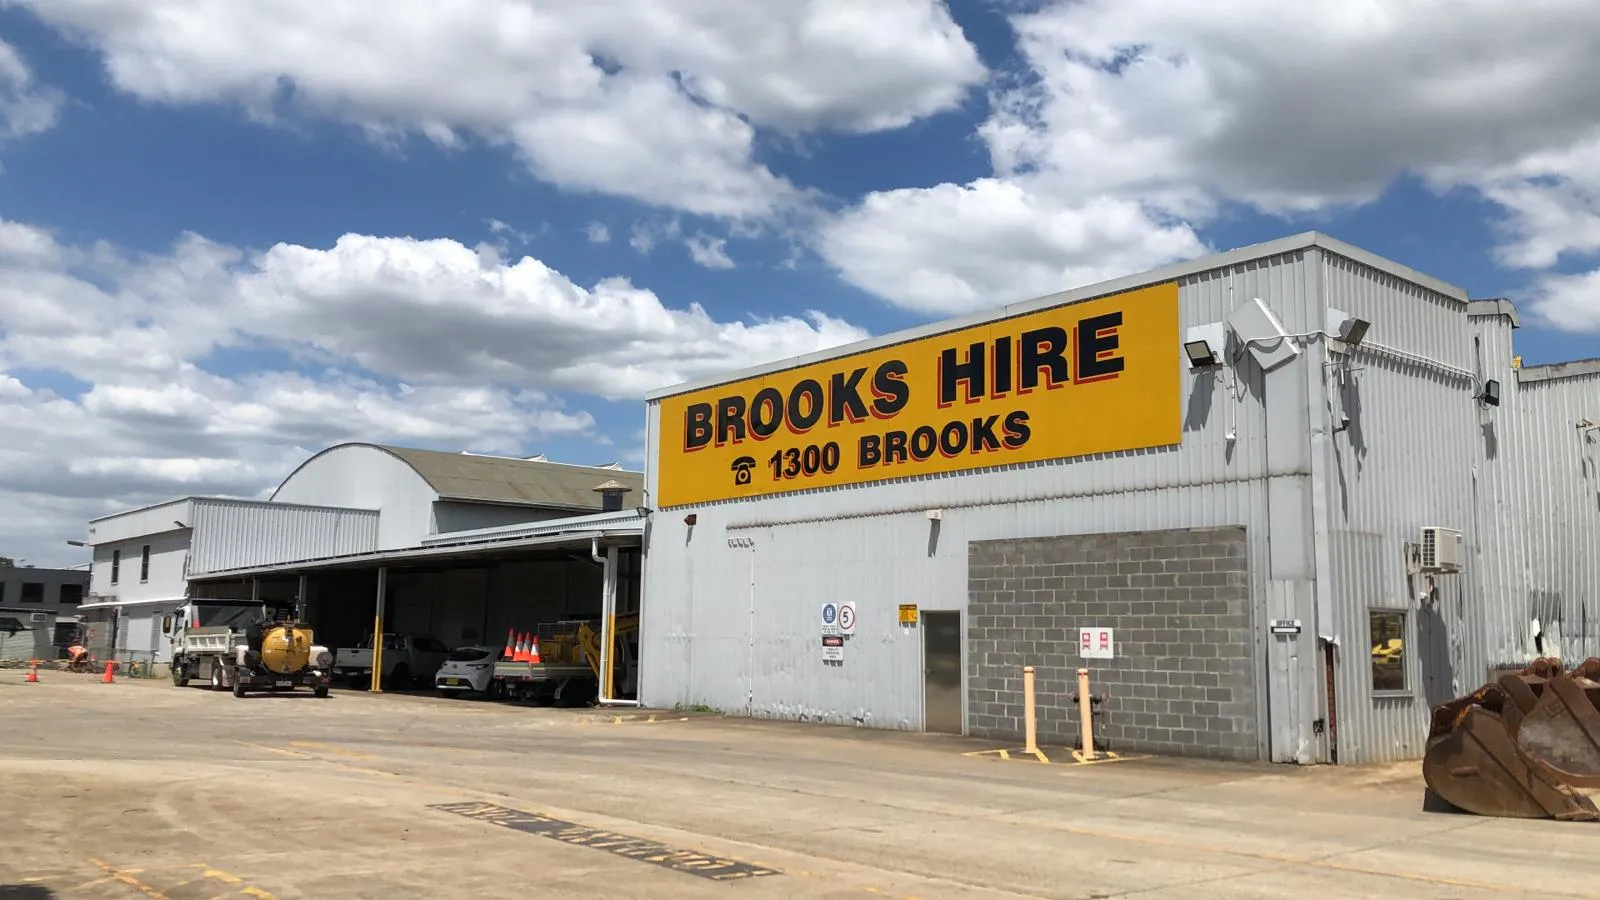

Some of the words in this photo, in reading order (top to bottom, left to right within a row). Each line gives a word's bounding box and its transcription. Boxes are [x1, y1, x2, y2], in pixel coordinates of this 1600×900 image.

[684, 359, 909, 453] BROOKS
[937, 311, 1125, 409] HIRE
[768, 441, 841, 482] 1300
[858, 410, 1031, 470] BROOKS
[843, 611, 849, 624] 5
